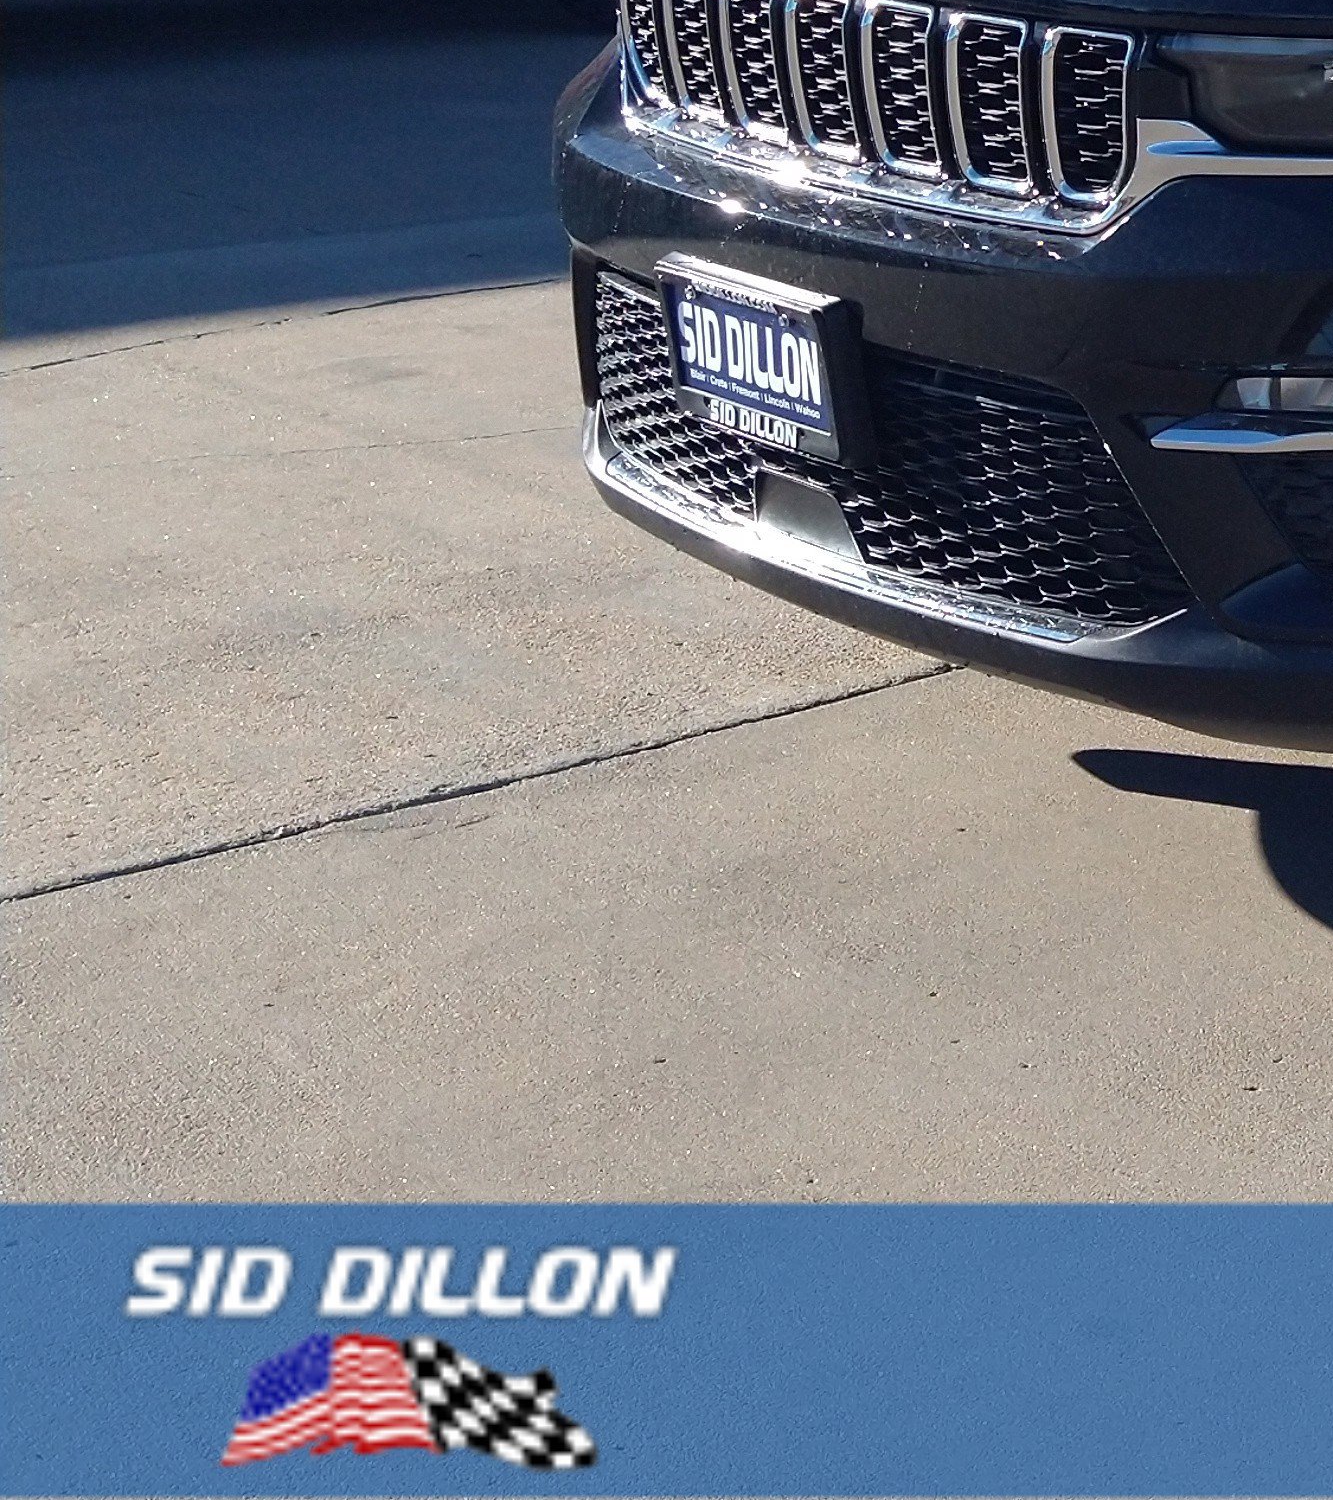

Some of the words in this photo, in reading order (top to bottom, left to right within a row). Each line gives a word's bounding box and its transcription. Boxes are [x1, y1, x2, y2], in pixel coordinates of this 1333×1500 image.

[678, 301, 722, 373] SID
[725, 314, 822, 406] DILLON
[710, 398, 735, 427] SID
[740, 408, 797, 449] DILLON
